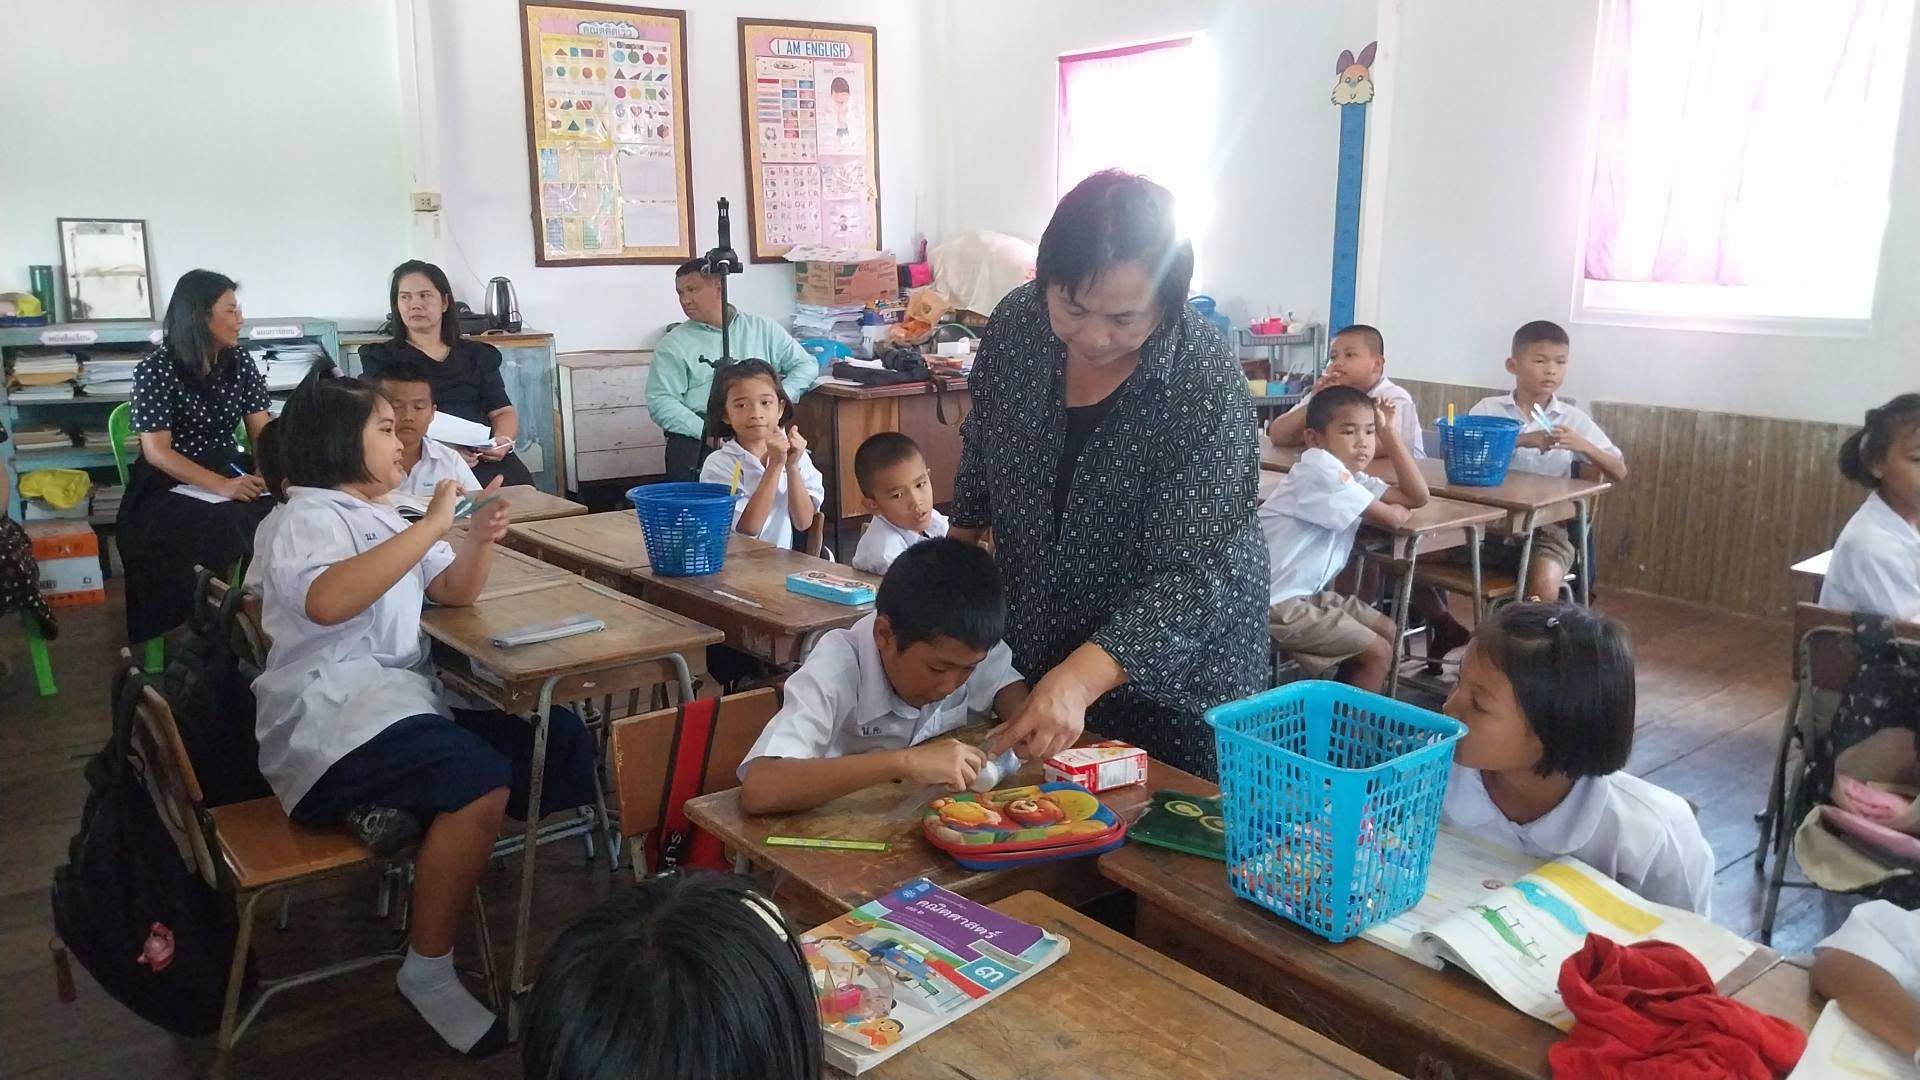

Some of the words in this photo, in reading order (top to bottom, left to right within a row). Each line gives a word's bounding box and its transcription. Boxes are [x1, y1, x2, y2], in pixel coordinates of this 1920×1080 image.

[777, 40, 780, 54] I
[786, 40, 801, 56] AM
[805, 42, 846, 58] ENGLISH
[916, 900, 1004, 939] คณิตศาสตร์
[975, 966, 1004, 983] ๓
